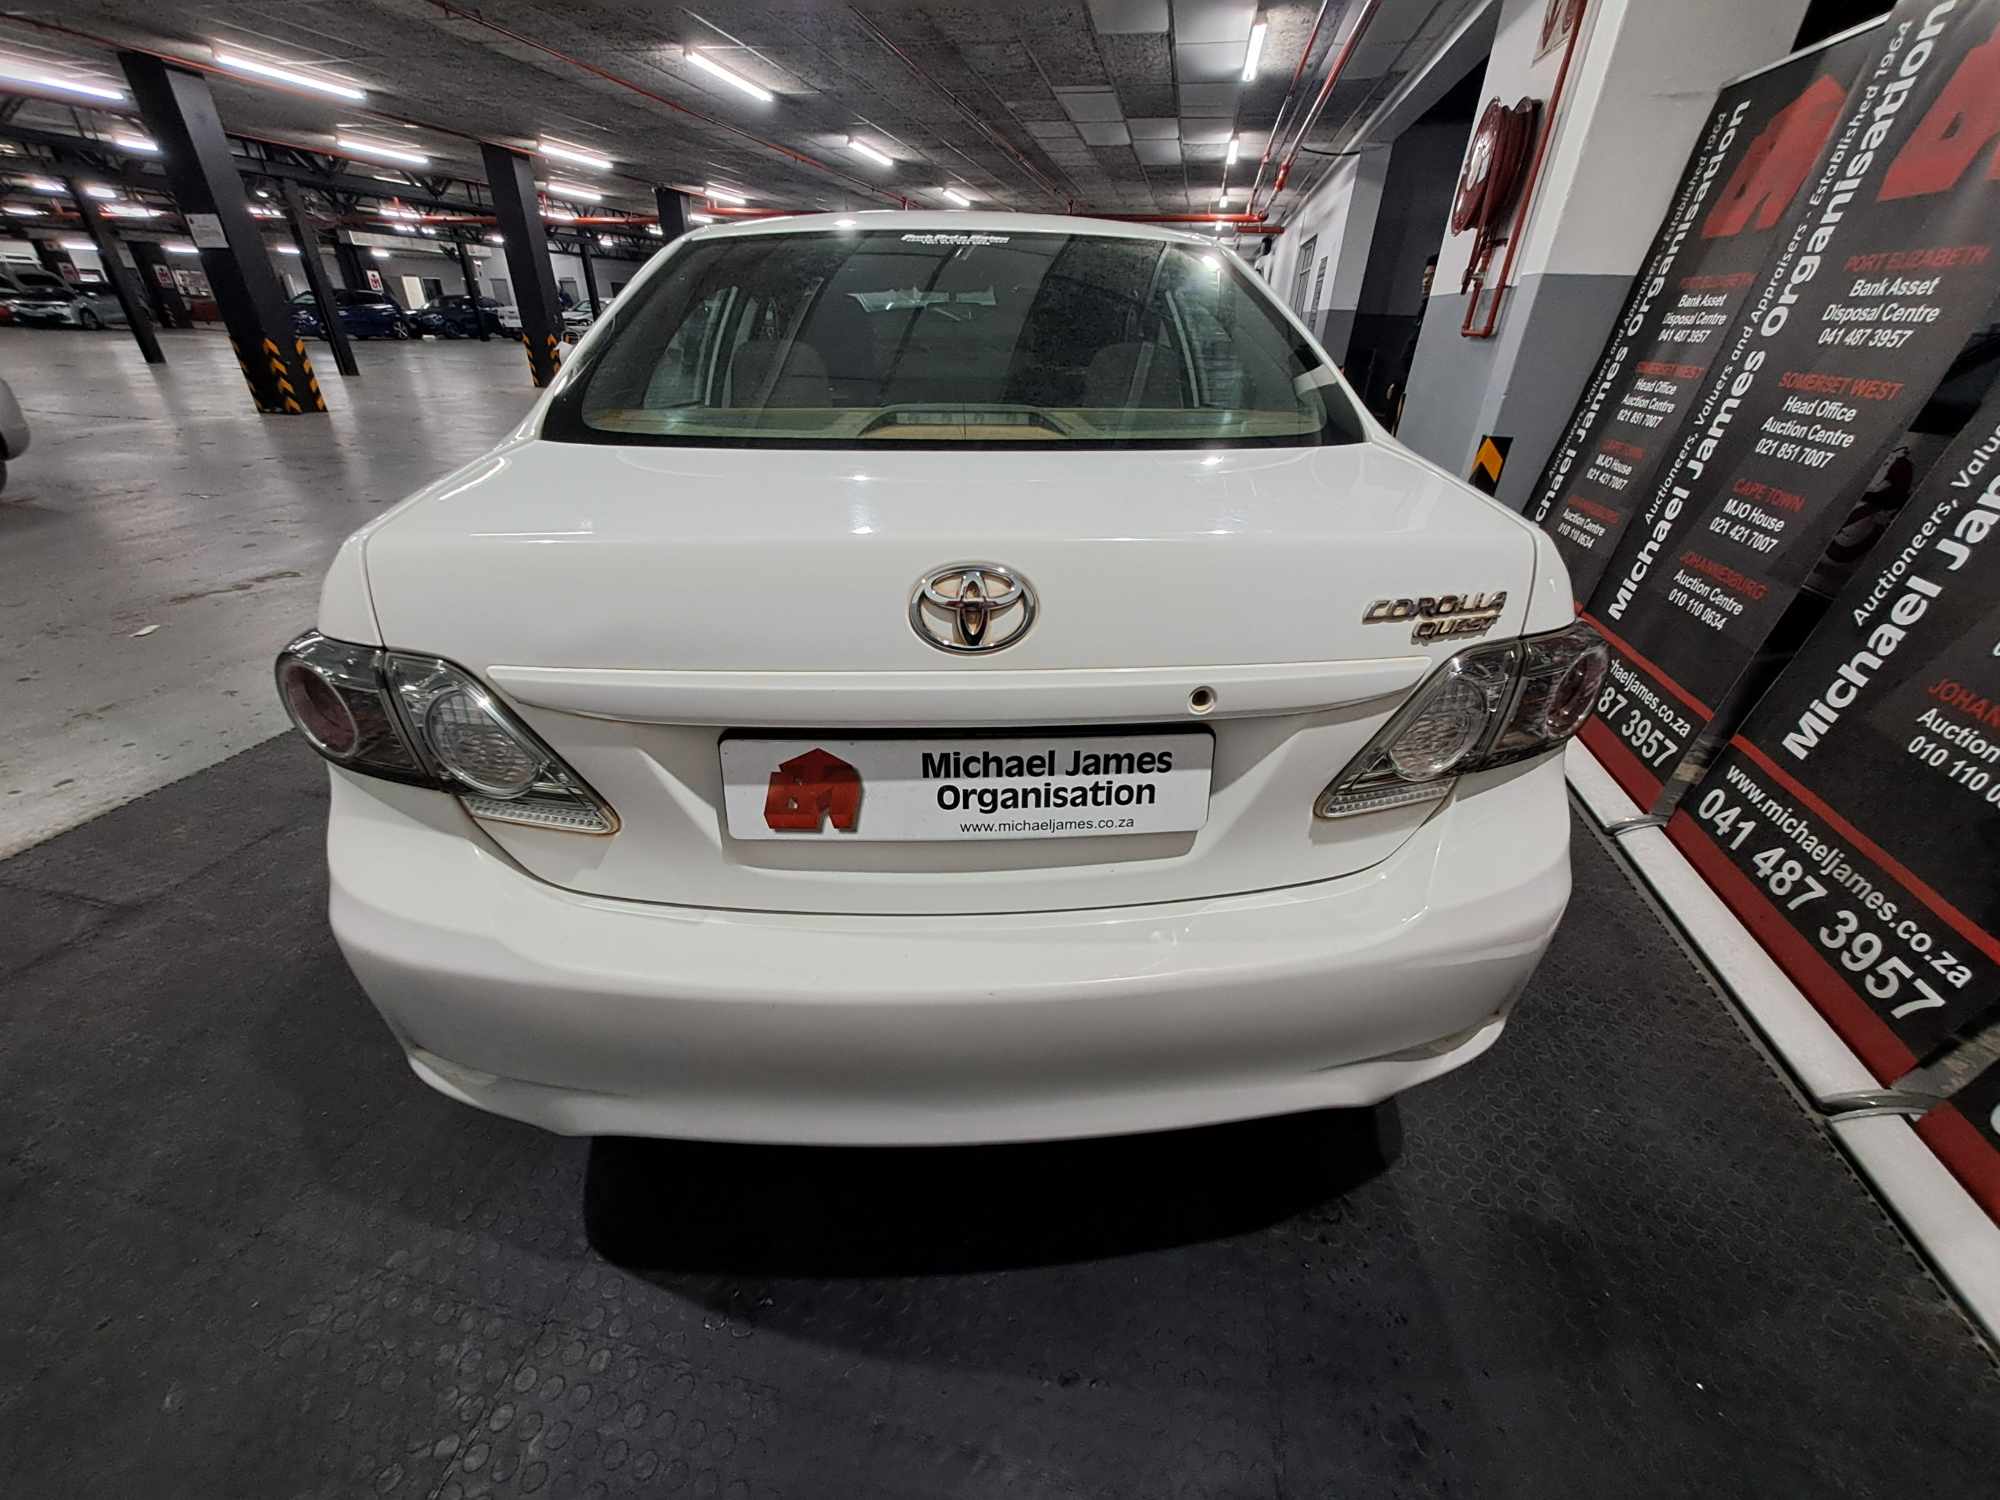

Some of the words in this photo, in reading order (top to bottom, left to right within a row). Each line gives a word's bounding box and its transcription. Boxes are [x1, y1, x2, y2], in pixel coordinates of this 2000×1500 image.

[1576, 346, 1629, 443] James
[1627, 100, 1751, 337] Organisation
[1645, 432, 1699, 525] Auctioneers,
[1694, 364, 1733, 425] Valuers
[1731, 326, 1753, 361] and
[1751, 224, 1808, 323] Appraisers
[1809, 85, 1880, 206] Established
[1873, 20, 1914, 79] 1964
[1849, 278, 1890, 297] Bank
[1888, 277, 1941, 295] Asset
[1607, 486, 1690, 621] Michael
[1687, 350, 1766, 480] James
[1761, 1, 1956, 337] Organisation
[1822, 303, 1883, 324] Disposal
[1882, 303, 1940, 322] Centre
[1818, 328, 1845, 344] 041
[1843, 328, 1871, 345] 487
[1869, 329, 1913, 348] 3957
[1778, 371, 1850, 393] SOMERSET
[1850, 379, 1904, 400] WEST
[1782, 396, 1819, 416] Head
[1816, 401, 1857, 422] Office
[1761, 416, 1808, 438] Auction
[1808, 424, 1855, 448] Centre
[1755, 438, 1780, 456] 021
[1776, 443, 1801, 462] 851
[1799, 448, 1835, 469] 7007
[1723, 498, 1751, 519] MJO
[1749, 506, 1785, 532] House
[1709, 516, 1730, 535] 021
[1729, 524, 1751, 543] 421
[1747, 530, 1779, 554] 7007
[1853, 499, 1958, 627] Auctioneers,
[1362, 591, 1507, 625] COROLLA
[1668, 588, 1688, 606] 010
[1686, 597, 1702, 617] 110
[1700, 608, 1728, 631] 0634
[1673, 569, 1711, 596] Auction
[1709, 588, 1744, 616] Centre
[1411, 615, 1501, 644] QUEST
[1782, 575, 1942, 760] Michael
[1610, 659, 1691, 738] haeljames.co.za
[1598, 687, 1629, 720] 87
[1621, 709, 1678, 767] 3957
[1916, 707, 2000, 763] Auction
[921, 750, 1056, 778] Michael
[1065, 750, 1173, 776] James
[1907, 735, 1949, 767] 010
[1949, 760, 1990, 791] 110
[936, 780, 1157, 815] Organisation
[959, 816, 1135, 834] www.michaeljames.co.za
[1726, 765, 1973, 989] www.michaeljames.co.za
[1698, 788, 1757, 850] 041
[1752, 847, 1828, 911] 487
[1819, 910, 1946, 1019] 3957
